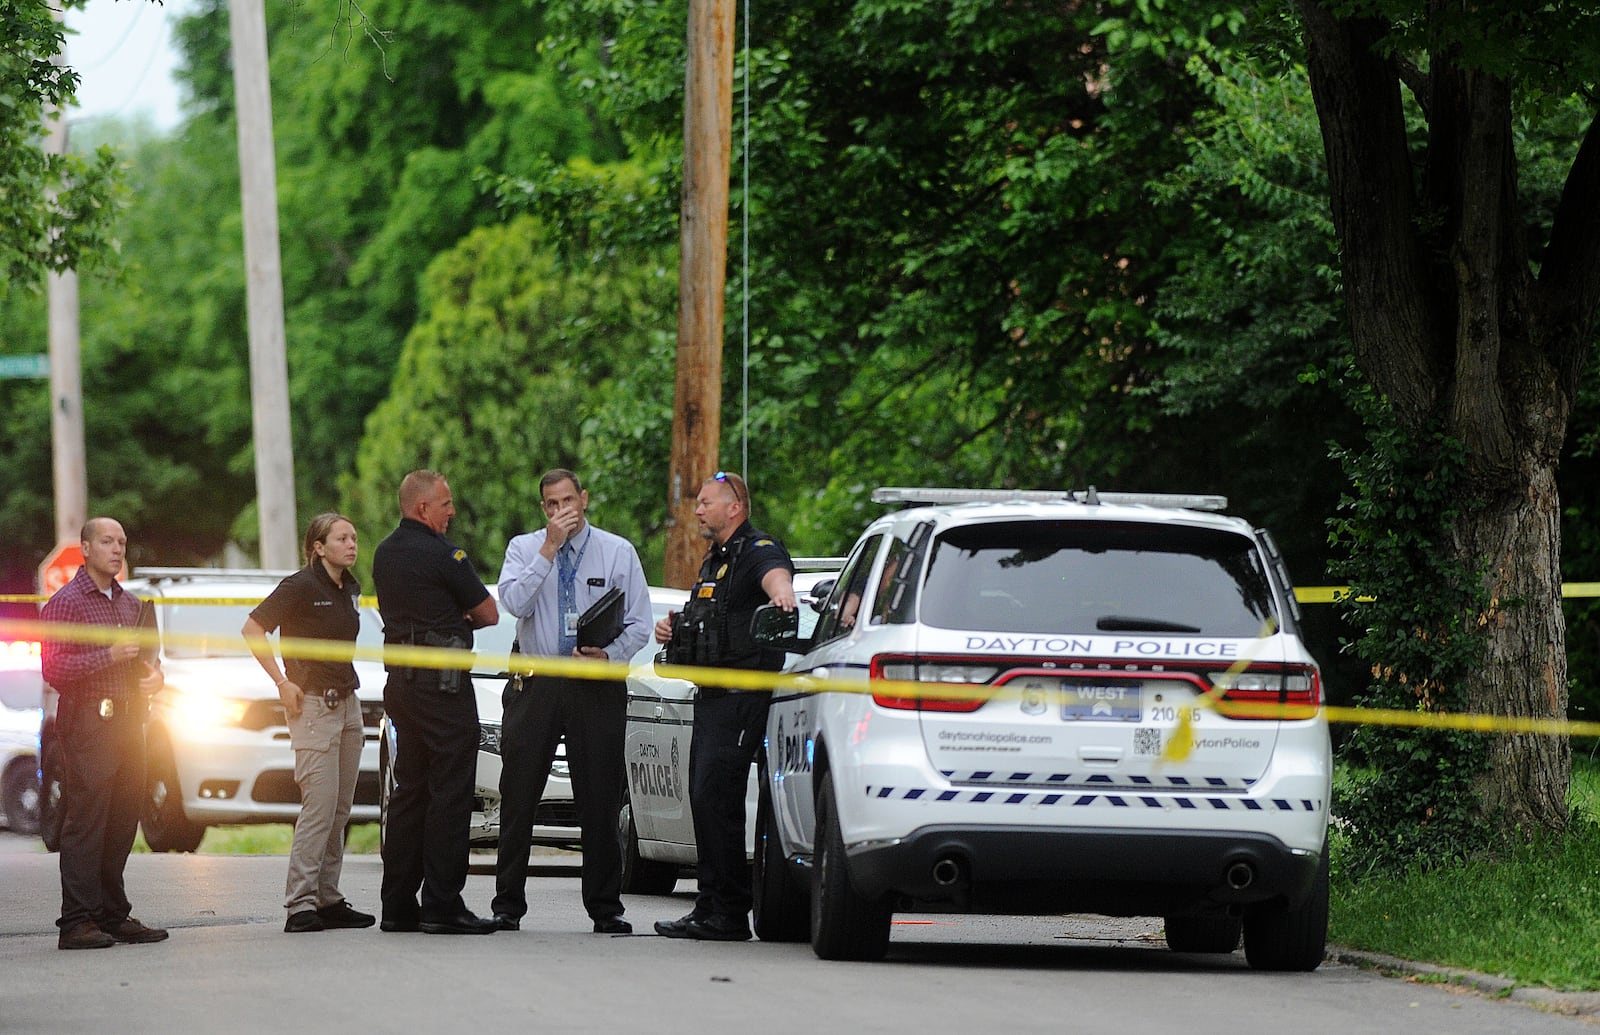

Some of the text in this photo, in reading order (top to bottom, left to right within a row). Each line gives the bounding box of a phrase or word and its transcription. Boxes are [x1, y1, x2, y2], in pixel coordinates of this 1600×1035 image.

[966, 637, 1238, 656] DAYTON POLICE
[1077, 687, 1128, 700] WEST
[1151, 707, 1201, 721] 2105
[938, 730, 1053, 744] daytonohiopolice.com
[630, 762, 674, 798] POLICE
